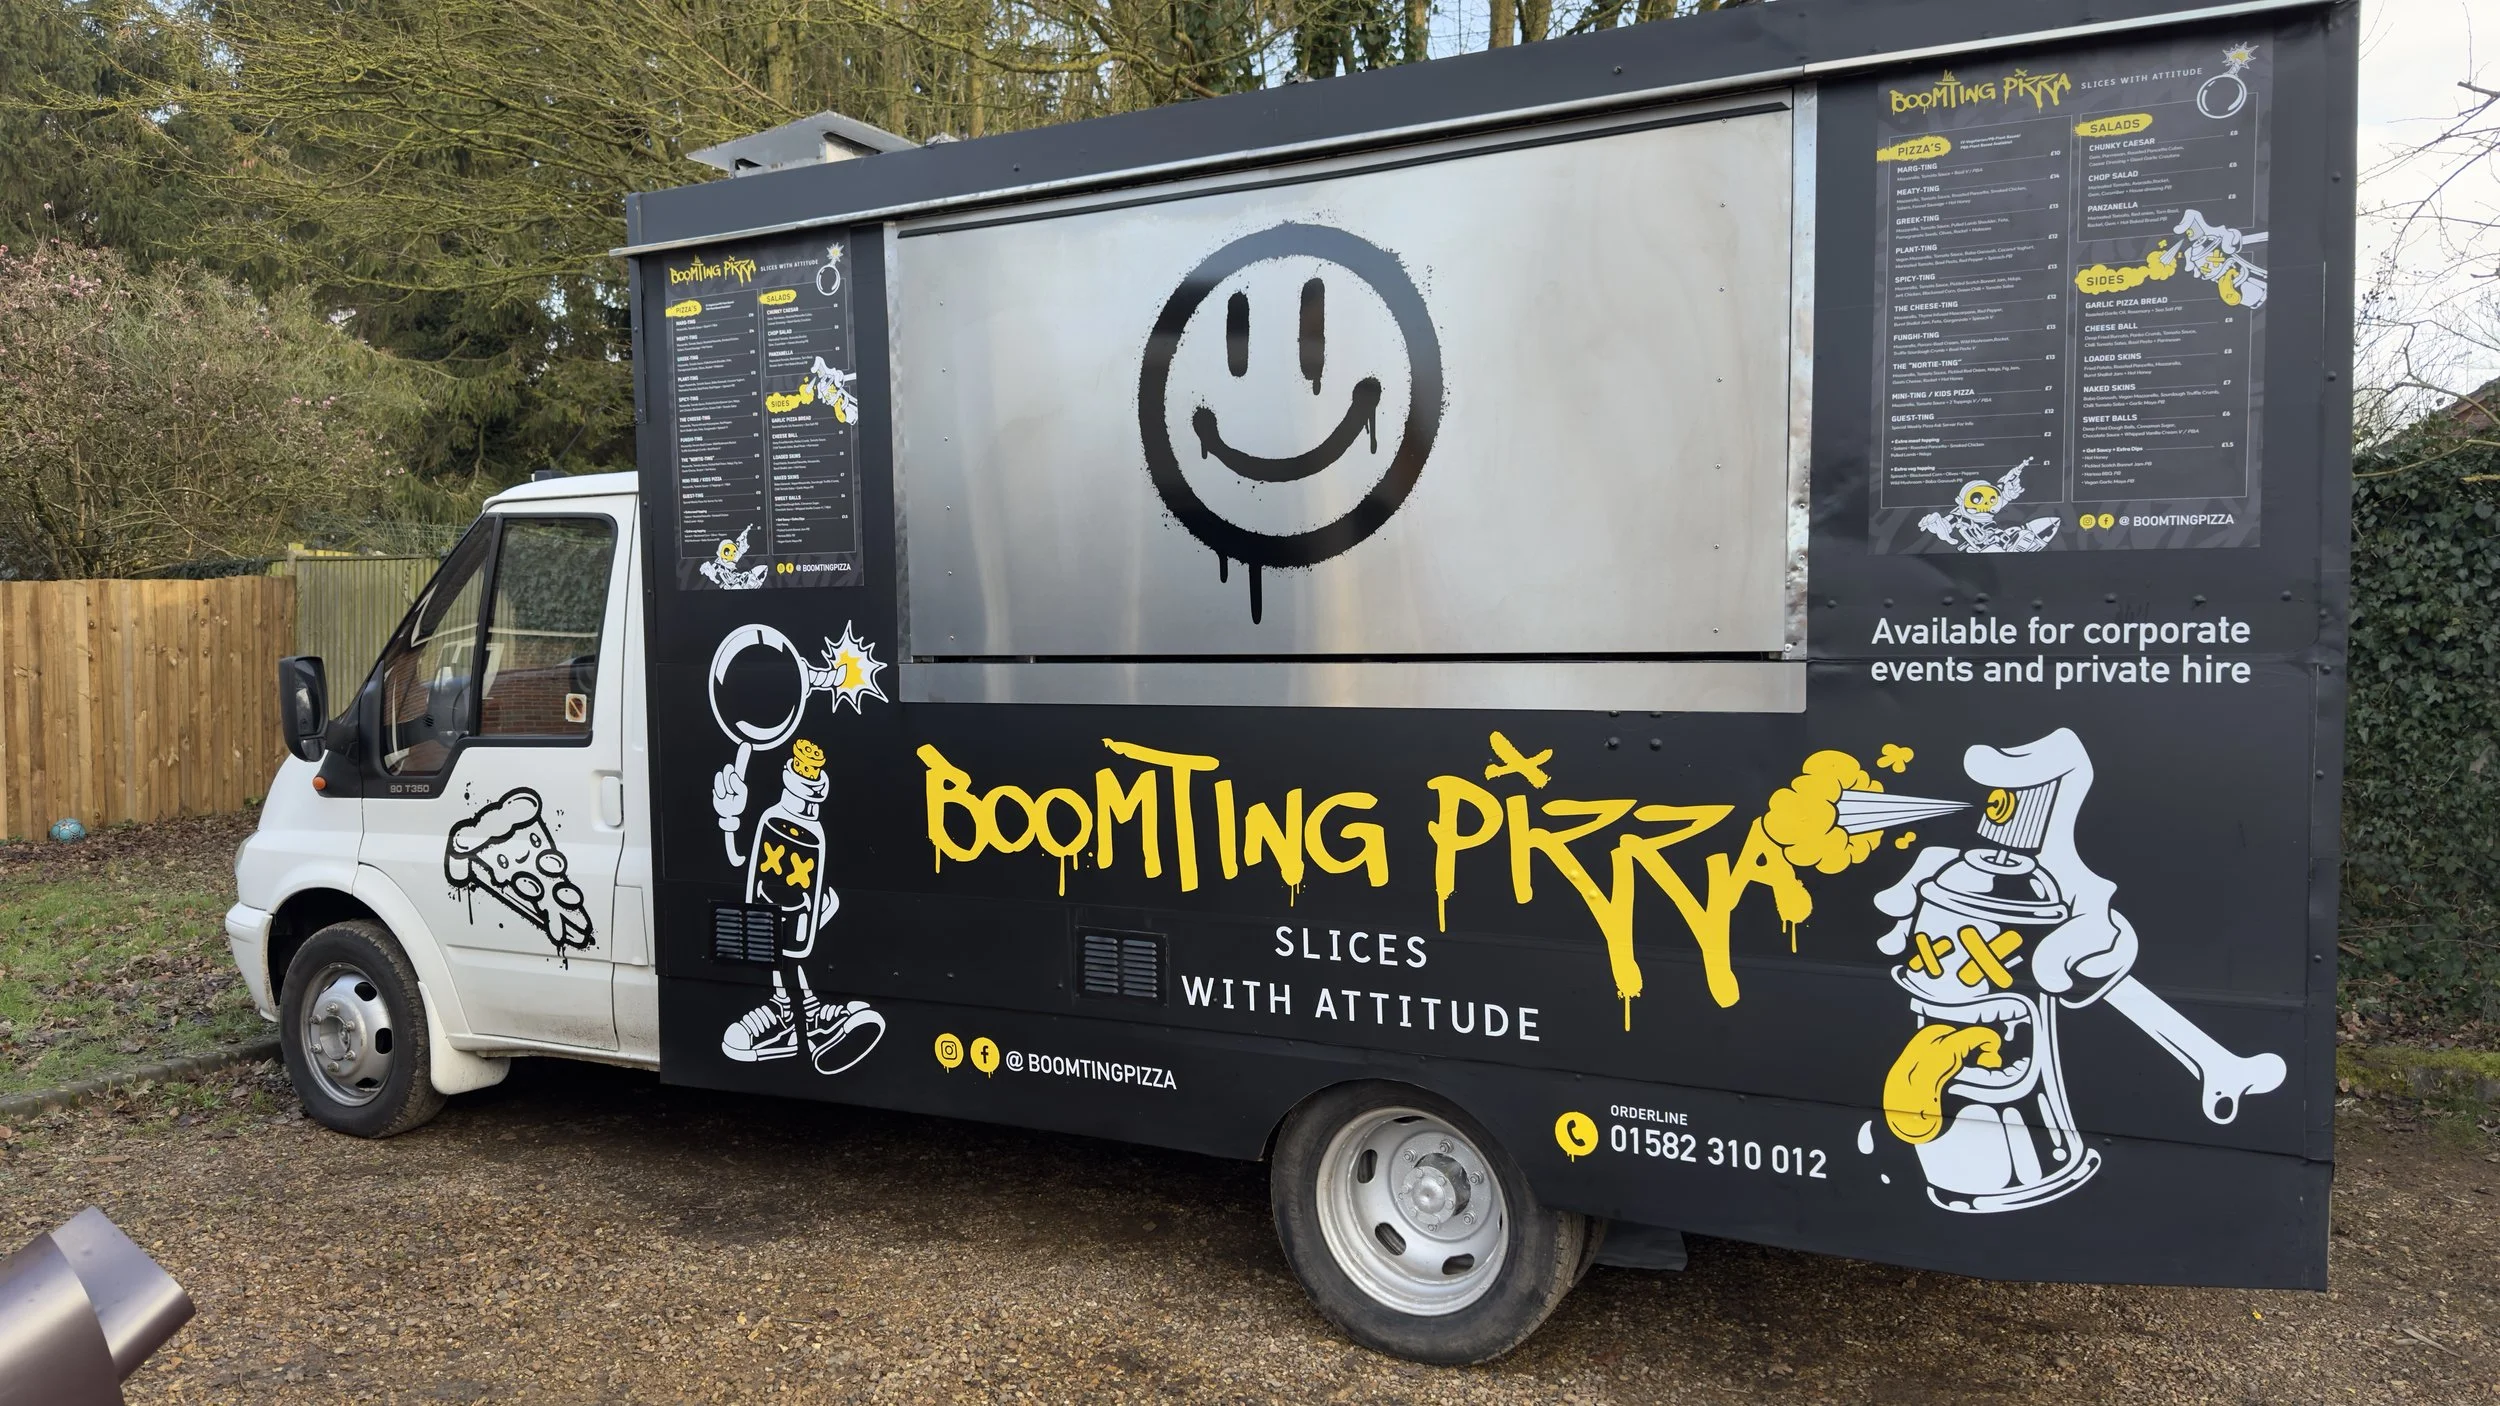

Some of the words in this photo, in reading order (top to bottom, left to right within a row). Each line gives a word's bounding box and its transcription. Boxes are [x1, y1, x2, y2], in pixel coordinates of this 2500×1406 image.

[2080, 77, 2116, 90] SLICES
[2120, 72, 2149, 84] WITH
[2152, 66, 2203, 80] ATTITUDE
[1890, 80, 1996, 114] BOOMTING
[2003, 68, 2071, 112] PIZZA
[2090, 119, 2140, 134] SALADS
[2089, 142, 2121, 152] CHUNKY
[2123, 138, 2155, 148] CAESAR
[1897, 163, 1937, 174] MARG-TING
[2088, 173, 2110, 182] CHOP
[2112, 171, 2138, 179] SALAD
[1897, 185, 1939, 196] MEATY-TING
[2088, 201, 2138, 213] PANZANELLA
[1896, 215, 1939, 225] GREEK-TING
[1896, 244, 1937, 254] PLANT-TING
[670, 264, 721, 285] BOOMTING
[724, 256, 756, 287] PIZZA
[760, 264, 778, 272] SLICES
[779, 262, 792, 270] WITH
[794, 259, 818, 268] ATTITUDE
[1895, 274, 1935, 283] SPICY-TING
[2086, 274, 2124, 286] SIDES
[767, 294, 790, 302] SALADS
[2086, 301, 2114, 309] GARLIC
[2116, 299, 2138, 307] PIZZA
[2141, 297, 2167, 305] BREAD
[1910, 301, 1958, 311] CHEESE-TING
[2085, 324, 2115, 332] CHEESE
[2118, 322, 2138, 330] BALL
[1894, 332, 1939, 341] FUNGHI-TING
[2084, 354, 2115, 363] LOADED
[2117, 353, 2141, 361] SKINS
[2083, 385, 2109, 393] NAKED
[1892, 392, 1926, 400] MINI-TING
[1892, 414, 1934, 422] GUEST-TING
[2083, 415, 2110, 423] SWEET
[2112, 414, 2137, 422] BALLS
[2119, 516, 2130, 527] @
[2133, 513, 2234, 527] BOOMTINGPIZZA
[803, 563, 851, 572] BOOMTINGPIZZA
[1872, 617, 2017, 644] Available
[2028, 616, 2075, 644] for
[2084, 617, 2250, 651] corporate
[1871, 657, 1973, 681] events
[1984, 655, 2043, 682] and
[2056, 655, 2170, 690] private
[2183, 655, 2251, 683] hire
[404, 784, 430, 792] T350
[917, 738, 1388, 907] BOOMTING
[1427, 731, 1813, 1031] PIZZA
[1275, 926, 1427, 968] SLICES
[1181, 976, 1290, 1015] WITH
[1315, 988, 1540, 1042] ATTITUDE
[1006, 1050, 1024, 1072] @
[1028, 1053, 1177, 1090] BOOMTINGPIZZA
[1610, 1105, 1688, 1126] ORDERLINE
[1611, 1125, 1697, 1162] 01582
[1708, 1137, 1762, 1170] 310
[1771, 1144, 1827, 1179] 012
